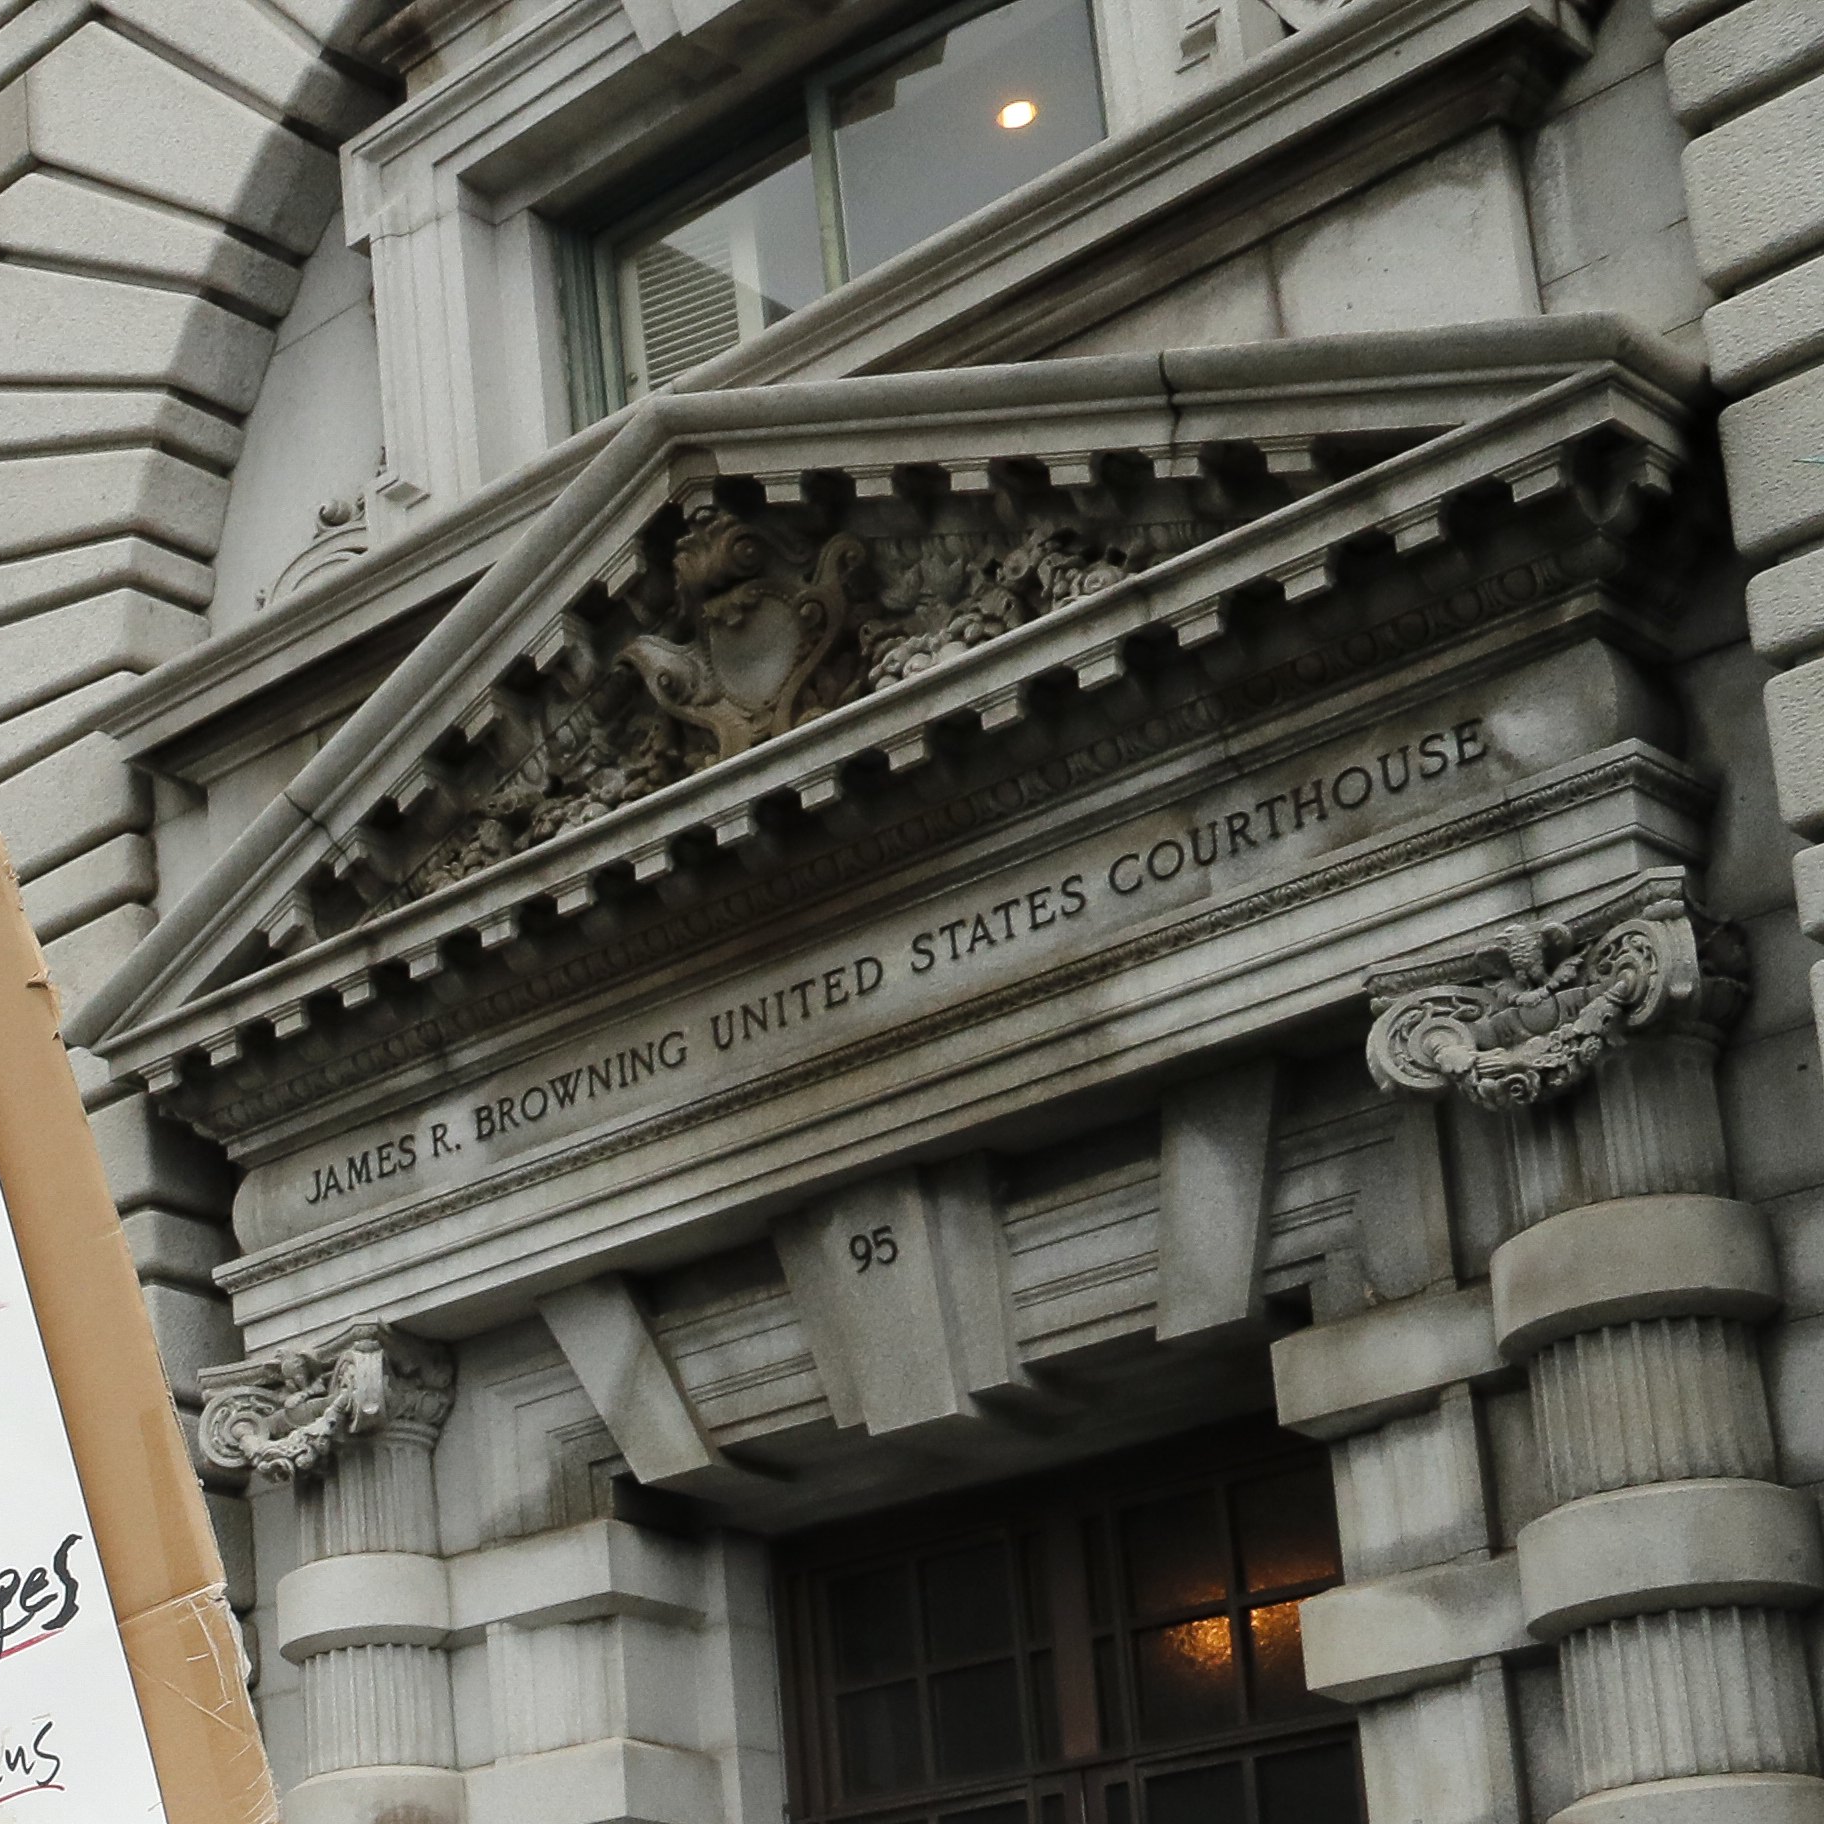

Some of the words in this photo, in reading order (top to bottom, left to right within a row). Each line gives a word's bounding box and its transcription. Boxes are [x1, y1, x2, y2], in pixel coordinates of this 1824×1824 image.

[305, 1134, 417, 1204] JAMES
[430, 1124, 463, 1159] R.
[473, 1030, 689, 1142] BROWNING
[709, 954, 883, 1051] UNITED
[909, 875, 1088, 973] STATES
[1107, 718, 1488, 896] COURTHOUSE
[848, 1225, 899, 1274] 95
